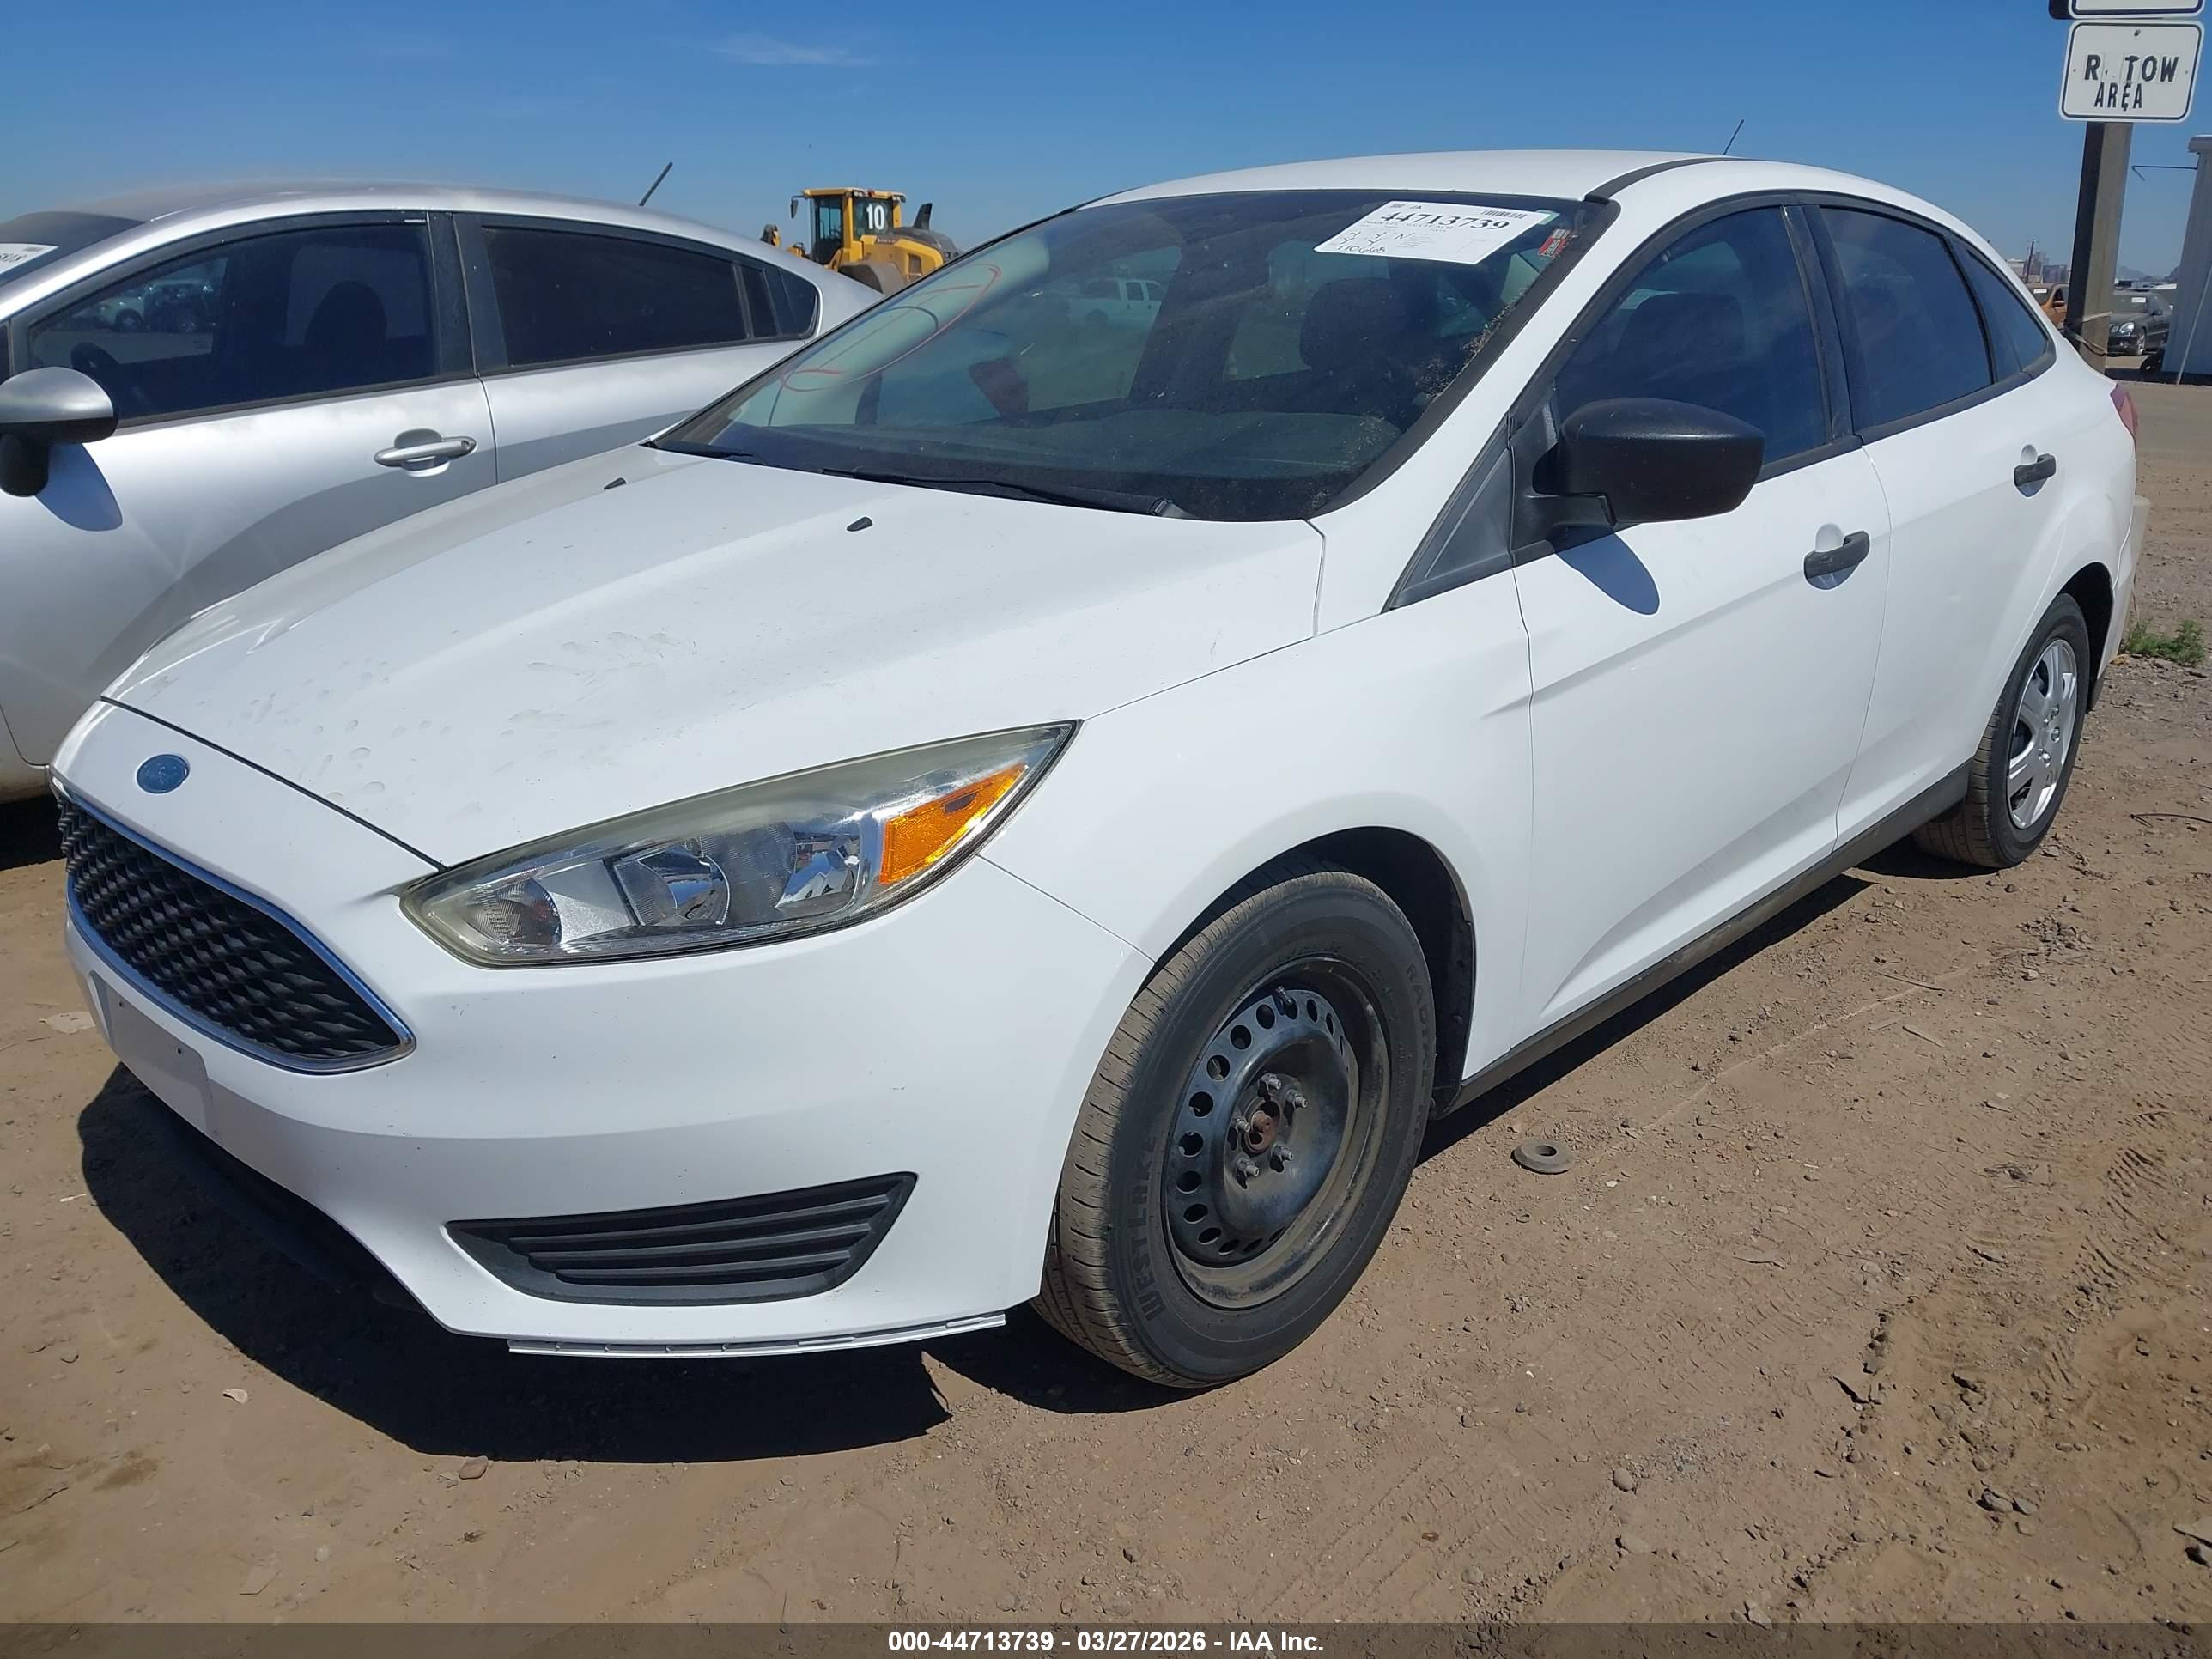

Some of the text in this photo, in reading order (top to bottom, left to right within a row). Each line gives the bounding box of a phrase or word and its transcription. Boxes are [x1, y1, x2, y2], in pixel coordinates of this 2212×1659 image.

[2124, 55, 2179, 82] TOW
[2094, 82, 2143, 112] AREA
[866, 204, 885, 230] 10
[1381, 211, 1510, 230] 44713739
